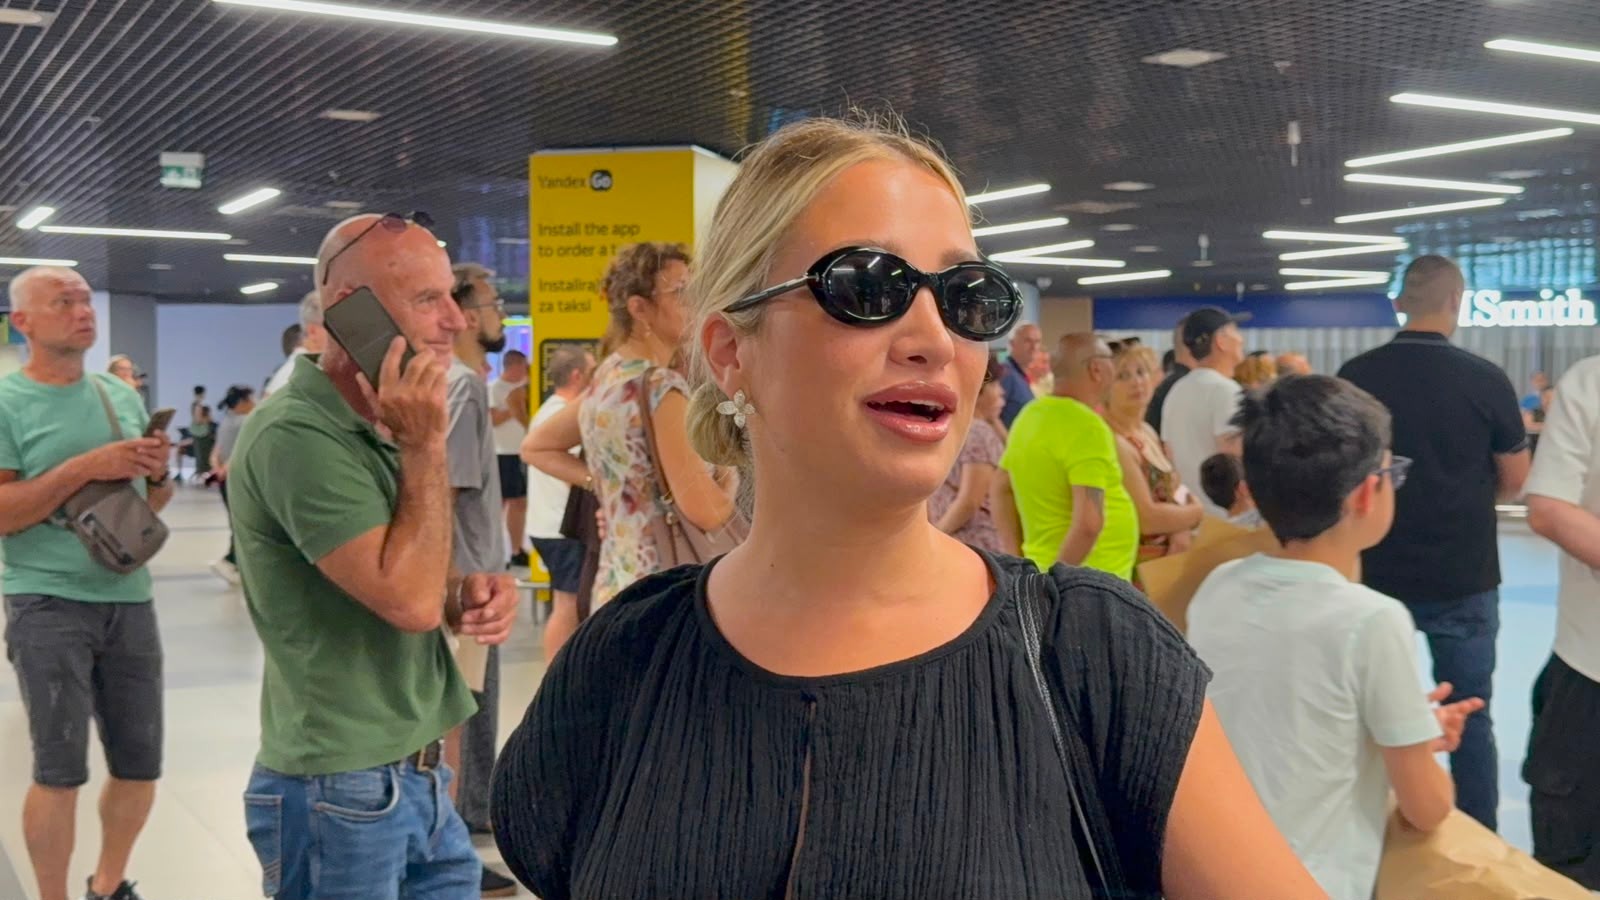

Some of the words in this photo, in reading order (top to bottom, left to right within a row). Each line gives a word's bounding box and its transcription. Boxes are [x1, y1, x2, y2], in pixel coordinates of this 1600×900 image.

[537, 175, 586, 189] Yandex
[591, 171, 612, 189] Go
[538, 223, 581, 237] Install
[584, 223, 608, 237] the
[612, 224, 641, 240] app
[538, 245, 553, 257] to
[557, 243, 595, 257] order
[600, 246, 608, 257] a
[539, 301, 554, 313] za
[558, 298, 592, 313] taksi
